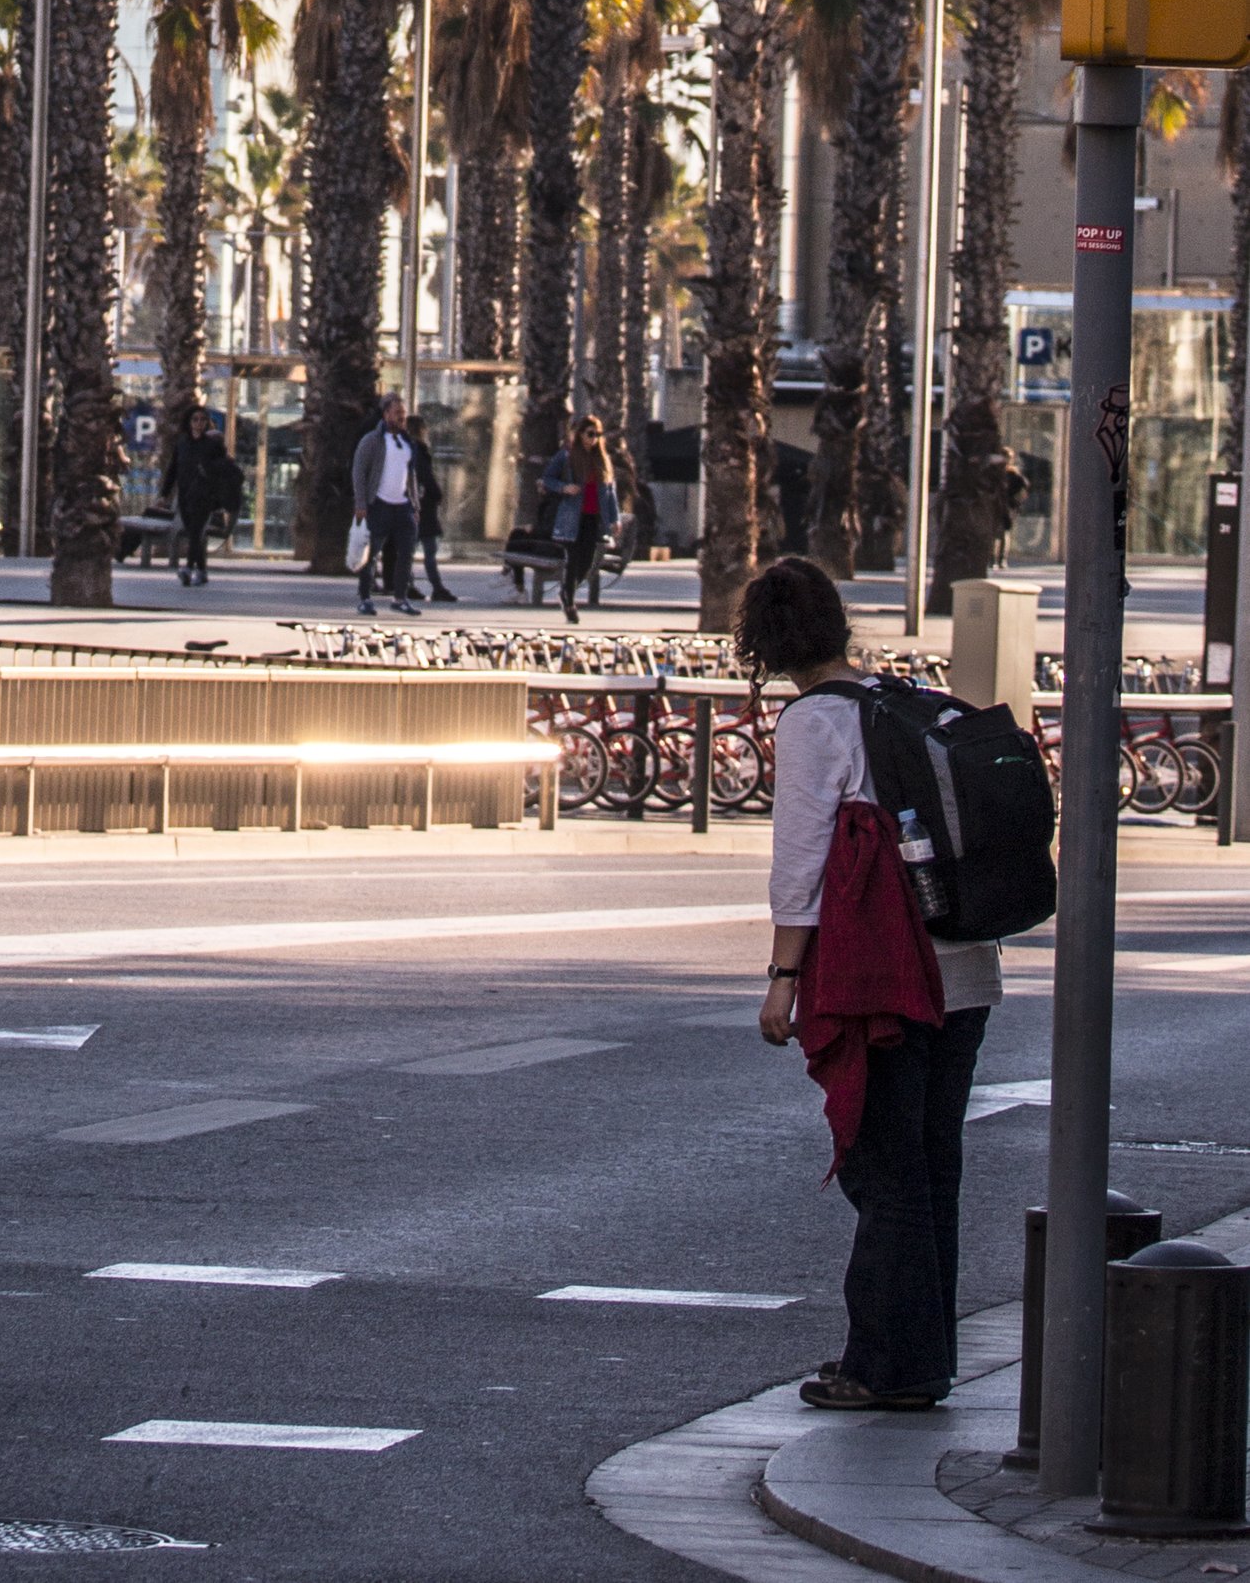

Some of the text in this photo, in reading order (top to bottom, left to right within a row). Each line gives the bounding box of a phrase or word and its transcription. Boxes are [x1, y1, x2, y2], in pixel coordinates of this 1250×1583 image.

[1077, 227, 1122, 239] POP UP
[1088, 242, 1121, 250] SESSIONS
[1025, 335, 1046, 358] P
[136, 416, 156, 442] P
